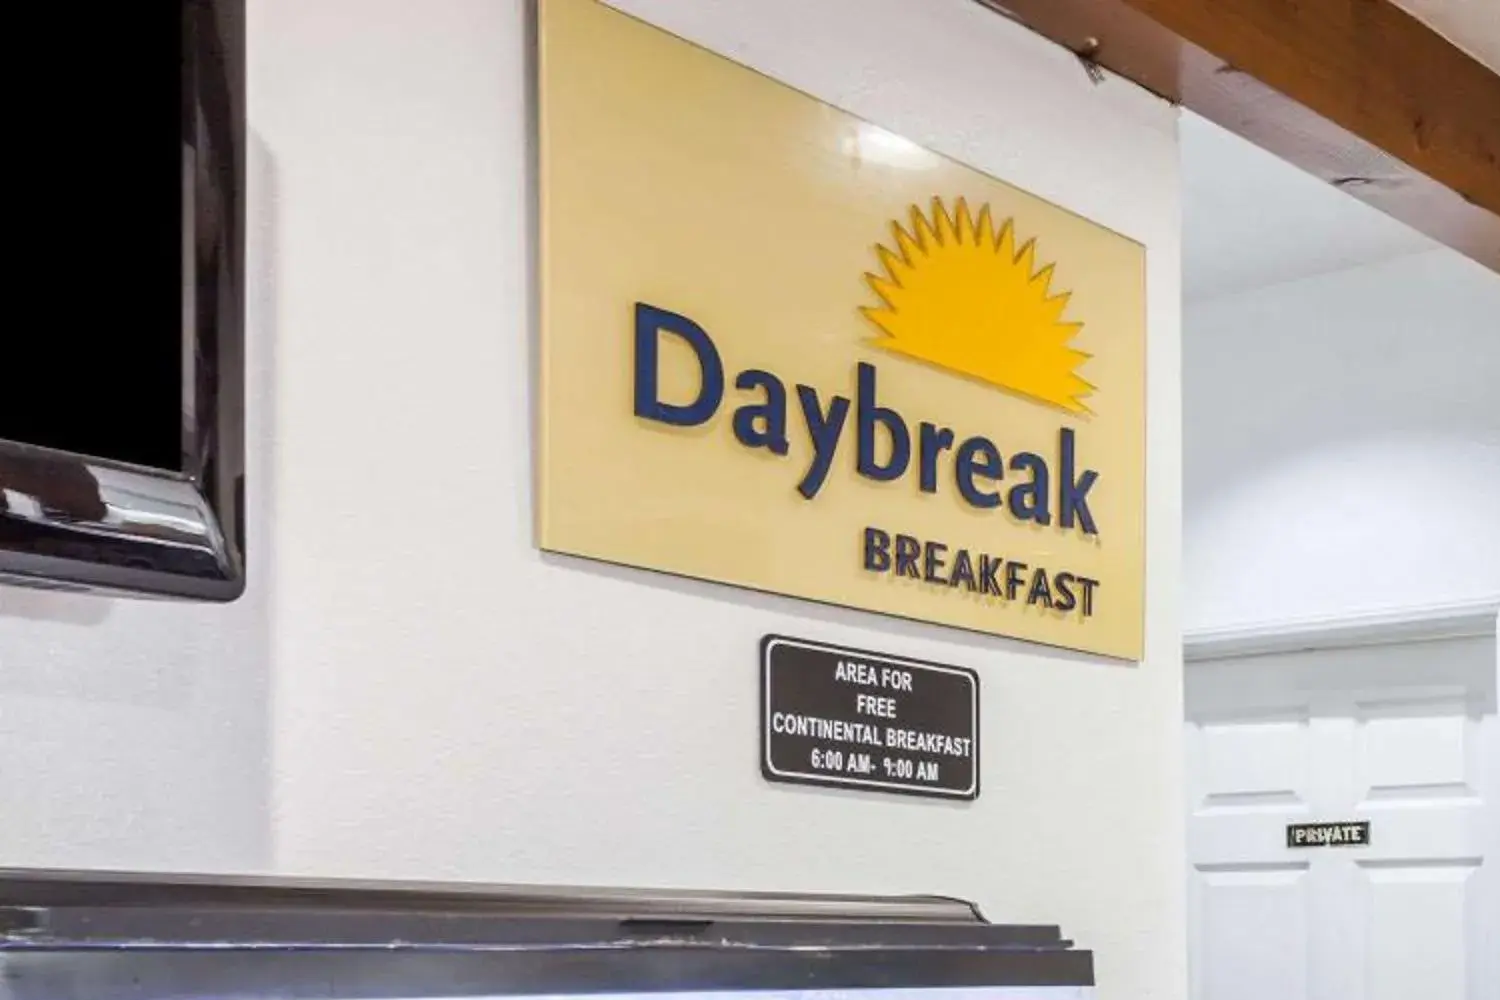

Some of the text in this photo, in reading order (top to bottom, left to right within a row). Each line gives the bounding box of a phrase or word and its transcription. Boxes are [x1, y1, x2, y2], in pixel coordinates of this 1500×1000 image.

[634, 302, 1100, 536] Daybreak
[863, 527, 1100, 617] BREAKFAST
[835, 661, 913, 692] AREA FOR
[856, 695, 897, 718] FREE
[773, 712, 972, 757] CONTINENTAL BREAKFAST
[811, 748, 843, 771] 6:00
[883, 757, 912, 779] 9:00
[916, 761, 939, 781] AM
[1294, 825, 1362, 843] PRIVATE
